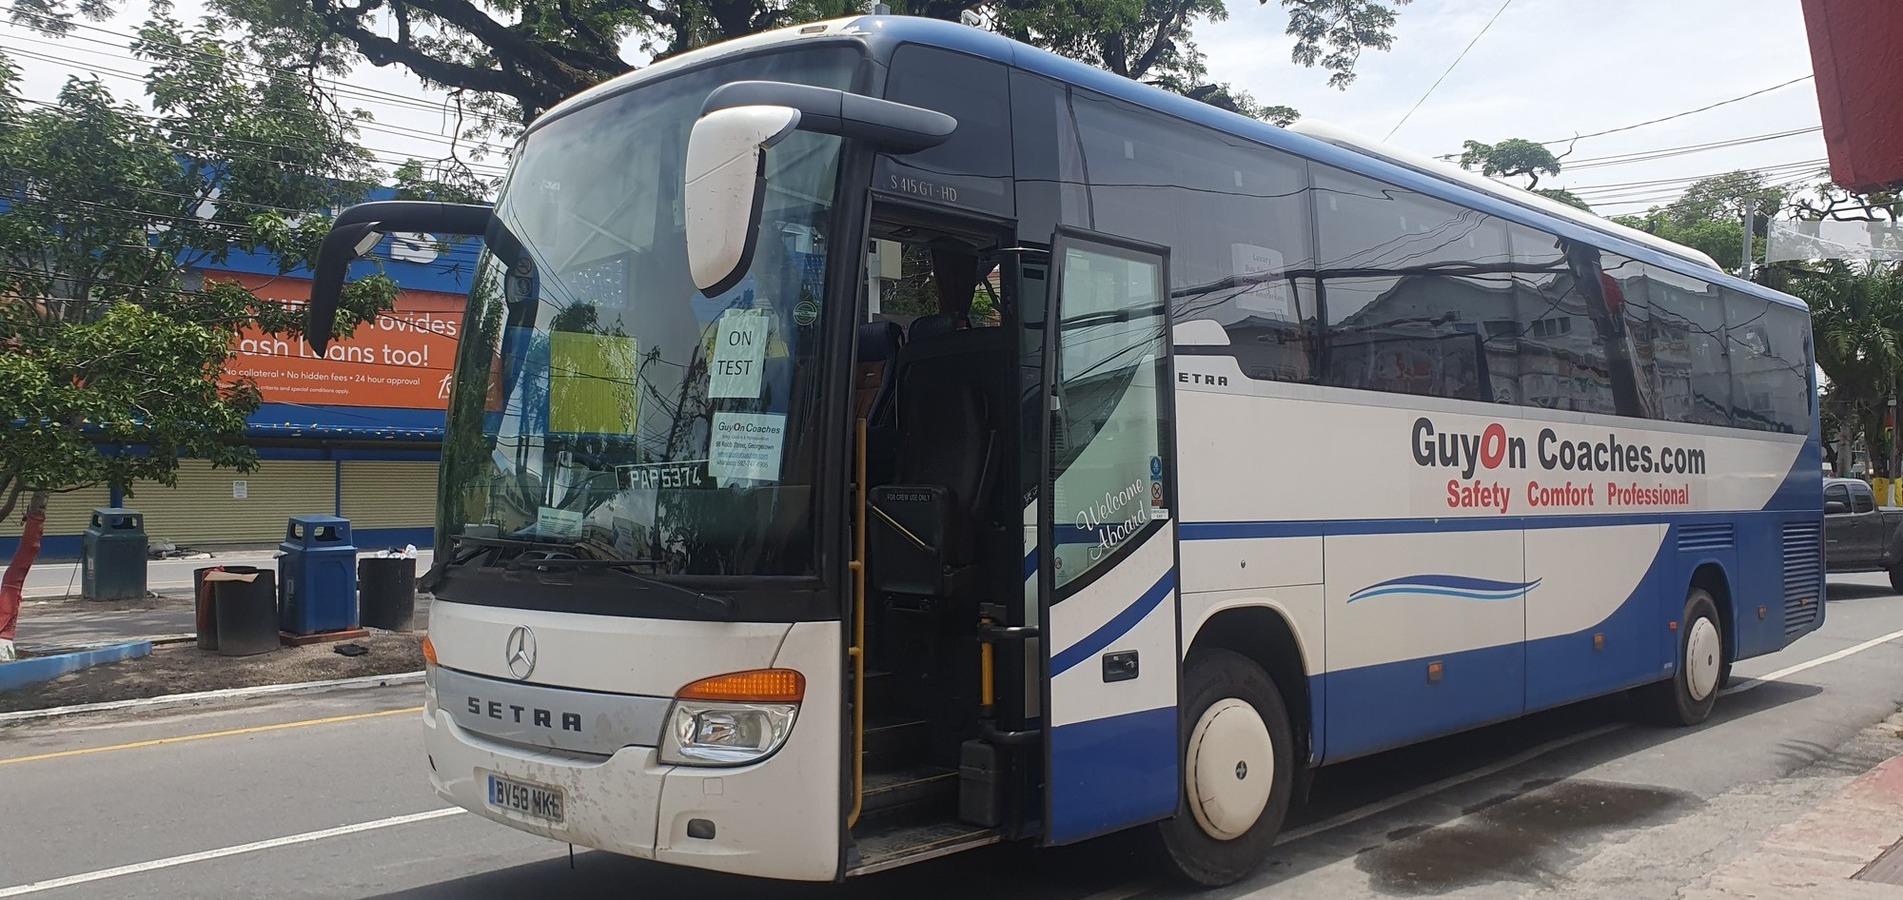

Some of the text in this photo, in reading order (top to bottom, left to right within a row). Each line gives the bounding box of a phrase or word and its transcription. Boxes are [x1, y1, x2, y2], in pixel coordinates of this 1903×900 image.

[890, 175, 898, 189] S
[900, 178, 917, 194] 415
[370, 312, 457, 336] rovides
[239, 332, 289, 357] ash
[382, 344, 429, 367] too!
[729, 330, 752, 347] ON
[239, 368, 279, 378] collateral
[287, 370, 299, 379] No
[301, 371, 330, 381] hidden
[331, 372, 348, 382] fees
[355, 374, 366, 383] 24
[367, 375, 386, 384] hour
[386, 377, 420, 387] approval
[717, 360, 753, 376] TEST
[1178, 372, 1228, 387] ETRA
[746, 423, 781, 434] Coaches
[1411, 416, 1706, 479] GuyOn Coaches.com
[1075, 478, 1145, 531] Welcome
[1447, 479, 1689, 514] Safety Comfort Professional
[1089, 500, 1147, 560] Aboard
[468, 696, 582, 732] SETRA
[496, 780, 529, 811] BV58
